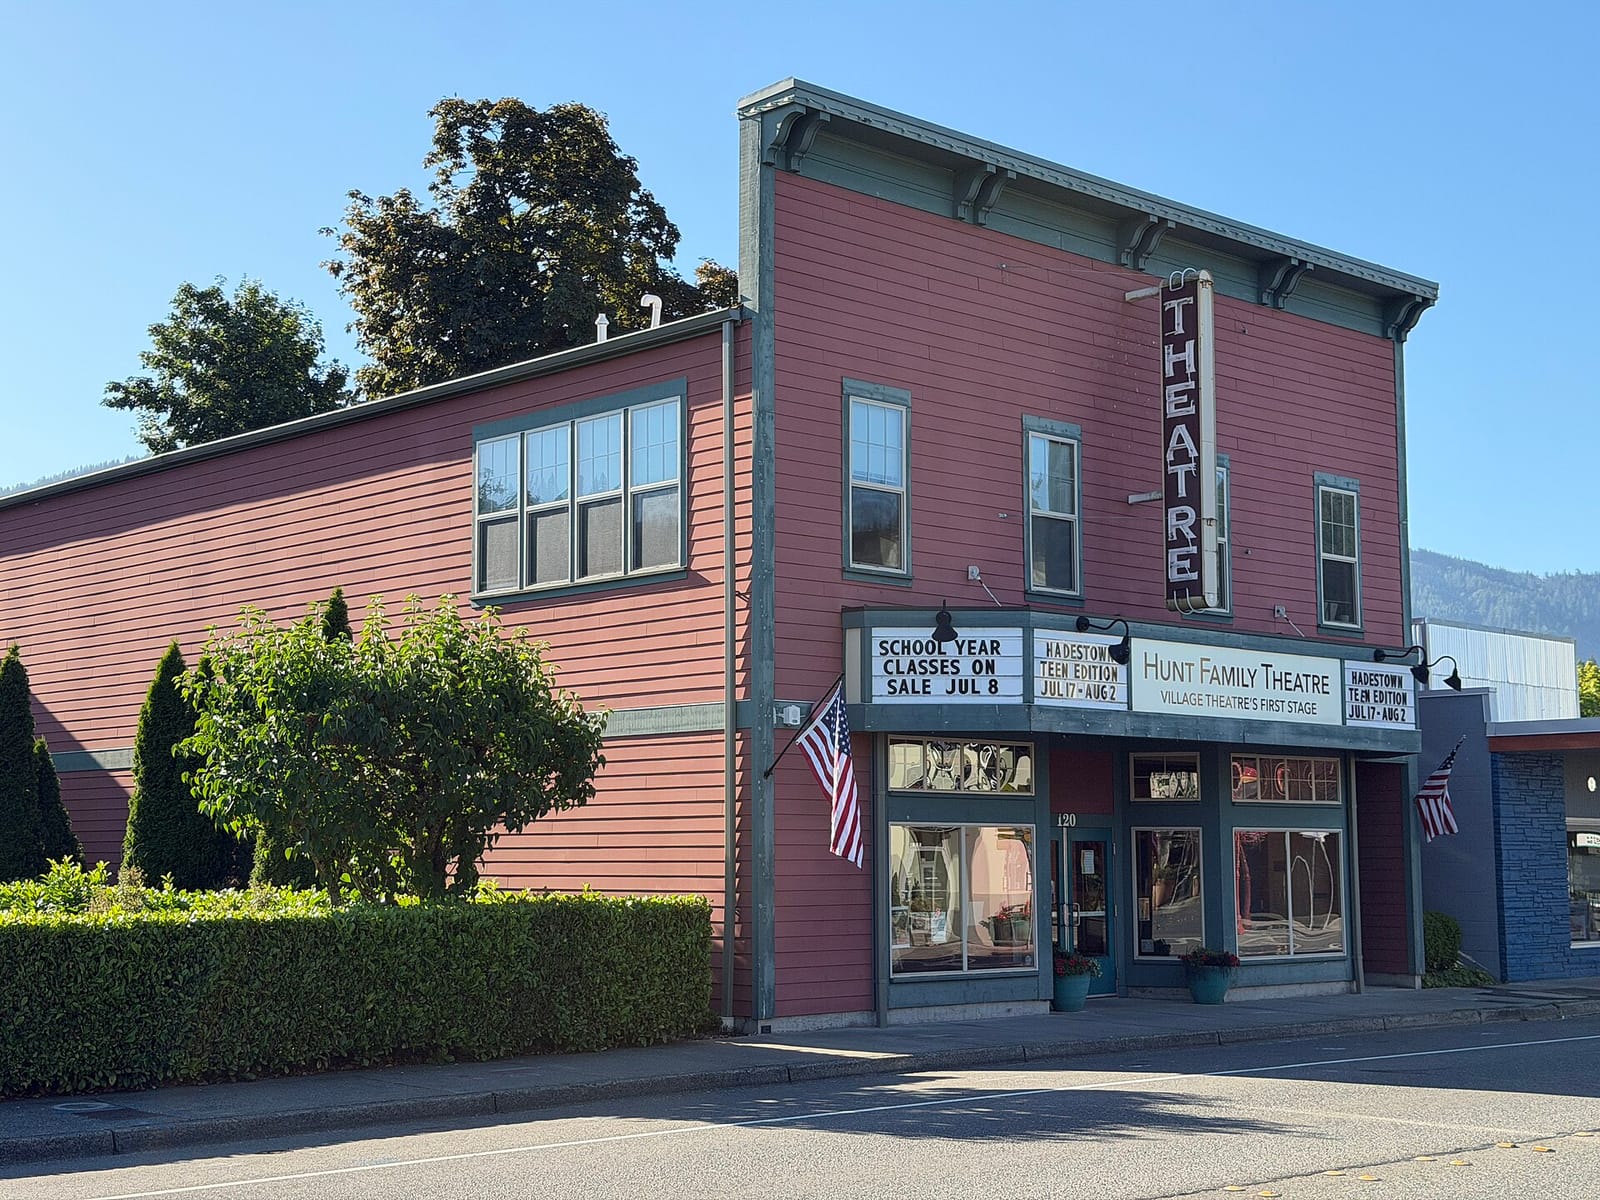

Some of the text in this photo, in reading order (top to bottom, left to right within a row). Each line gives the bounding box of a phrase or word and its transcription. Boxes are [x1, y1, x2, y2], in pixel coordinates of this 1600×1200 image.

[1163, 296, 1199, 582] THEATRE
[879, 639, 1001, 656] SCHOOL YEAR
[883, 659, 996, 675] CLASSES ON
[1040, 661, 1118, 682] TEEN EDITION
[887, 678, 999, 695] SALE JUL 8
[1351, 671, 1403, 689] HADESTOWN
[1161, 690, 1317, 715] VILLAGE THEATRE'S FIRST STAGE
[1349, 687, 1407, 706] TEEN EDITION
[1057, 813, 1077, 827] 120
